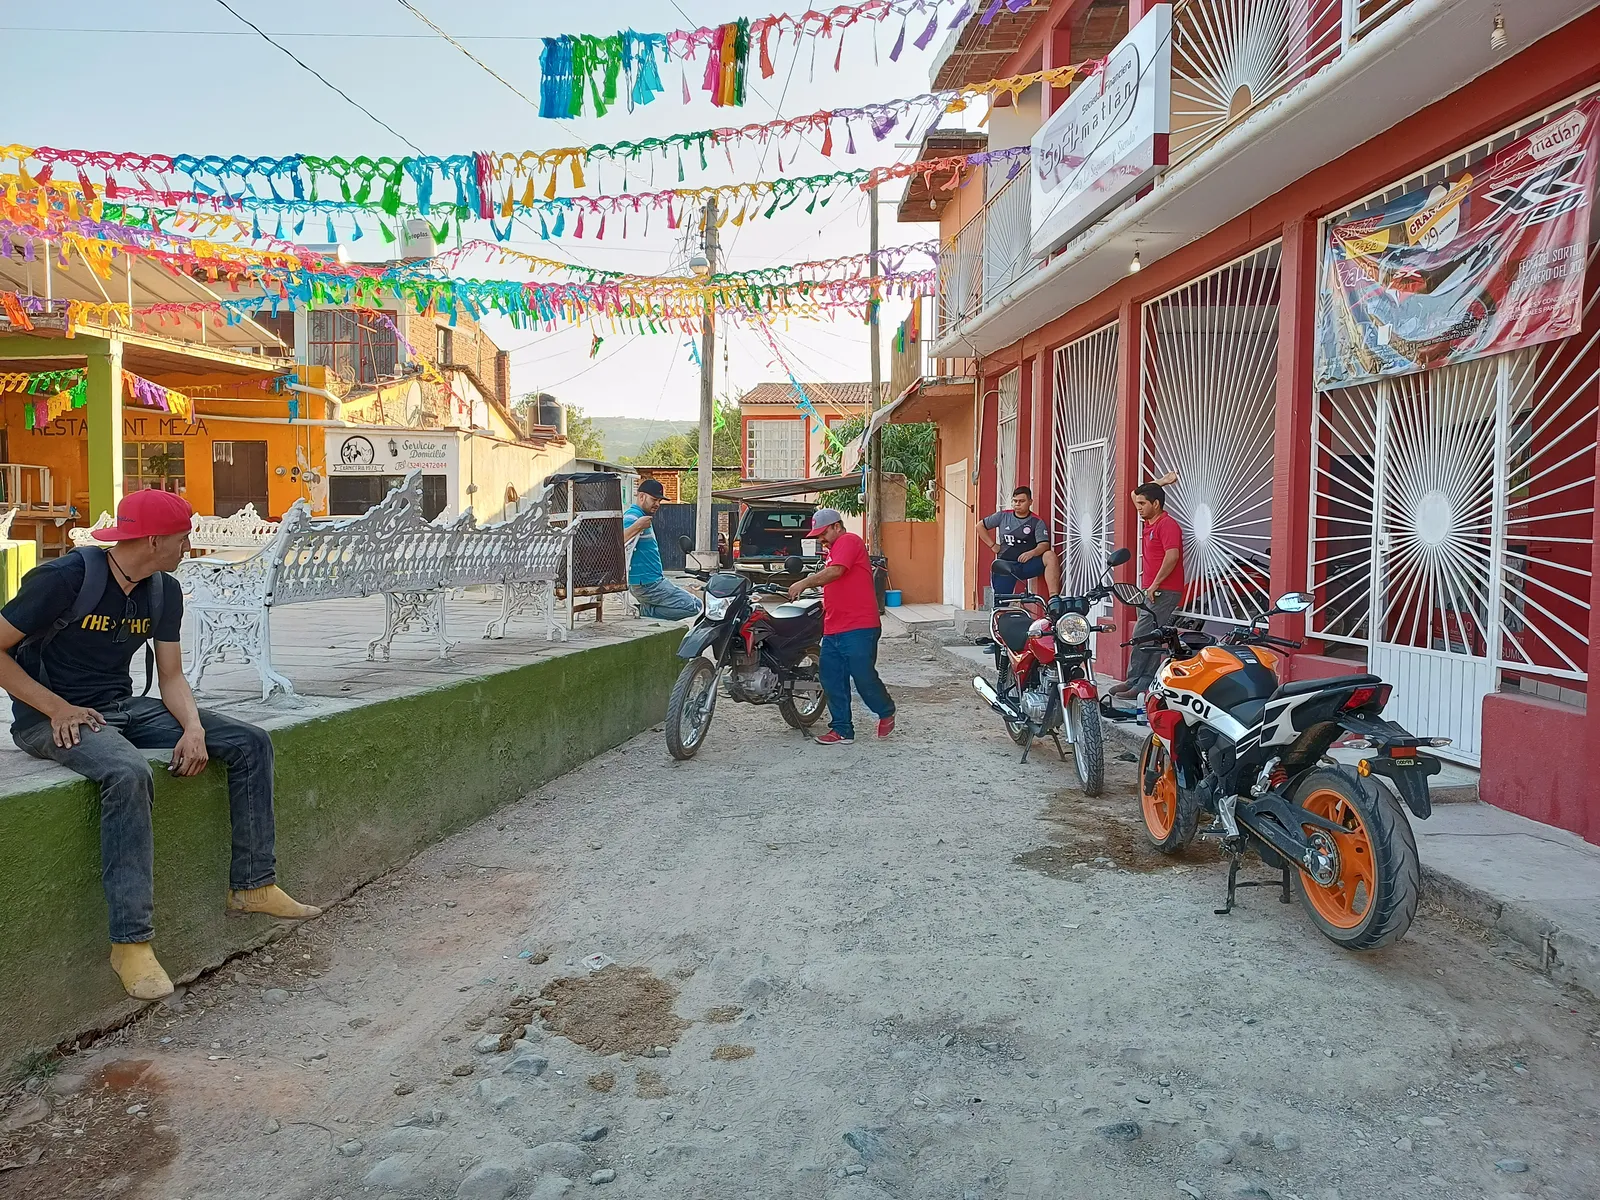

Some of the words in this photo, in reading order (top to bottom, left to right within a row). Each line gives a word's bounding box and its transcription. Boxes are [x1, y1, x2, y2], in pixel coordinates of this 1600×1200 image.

[1081, 87, 1104, 115] Socieda
[1104, 60, 1131, 92] Financiera
[1409, 205, 1437, 236] GRAN
[1424, 226, 1439, 249] 29
[31, 418, 147, 436] RESTANT
[159, 418, 208, 436] MEZA
[402, 440, 436, 450] Servicio
[409, 449, 446, 459] Domicilio
